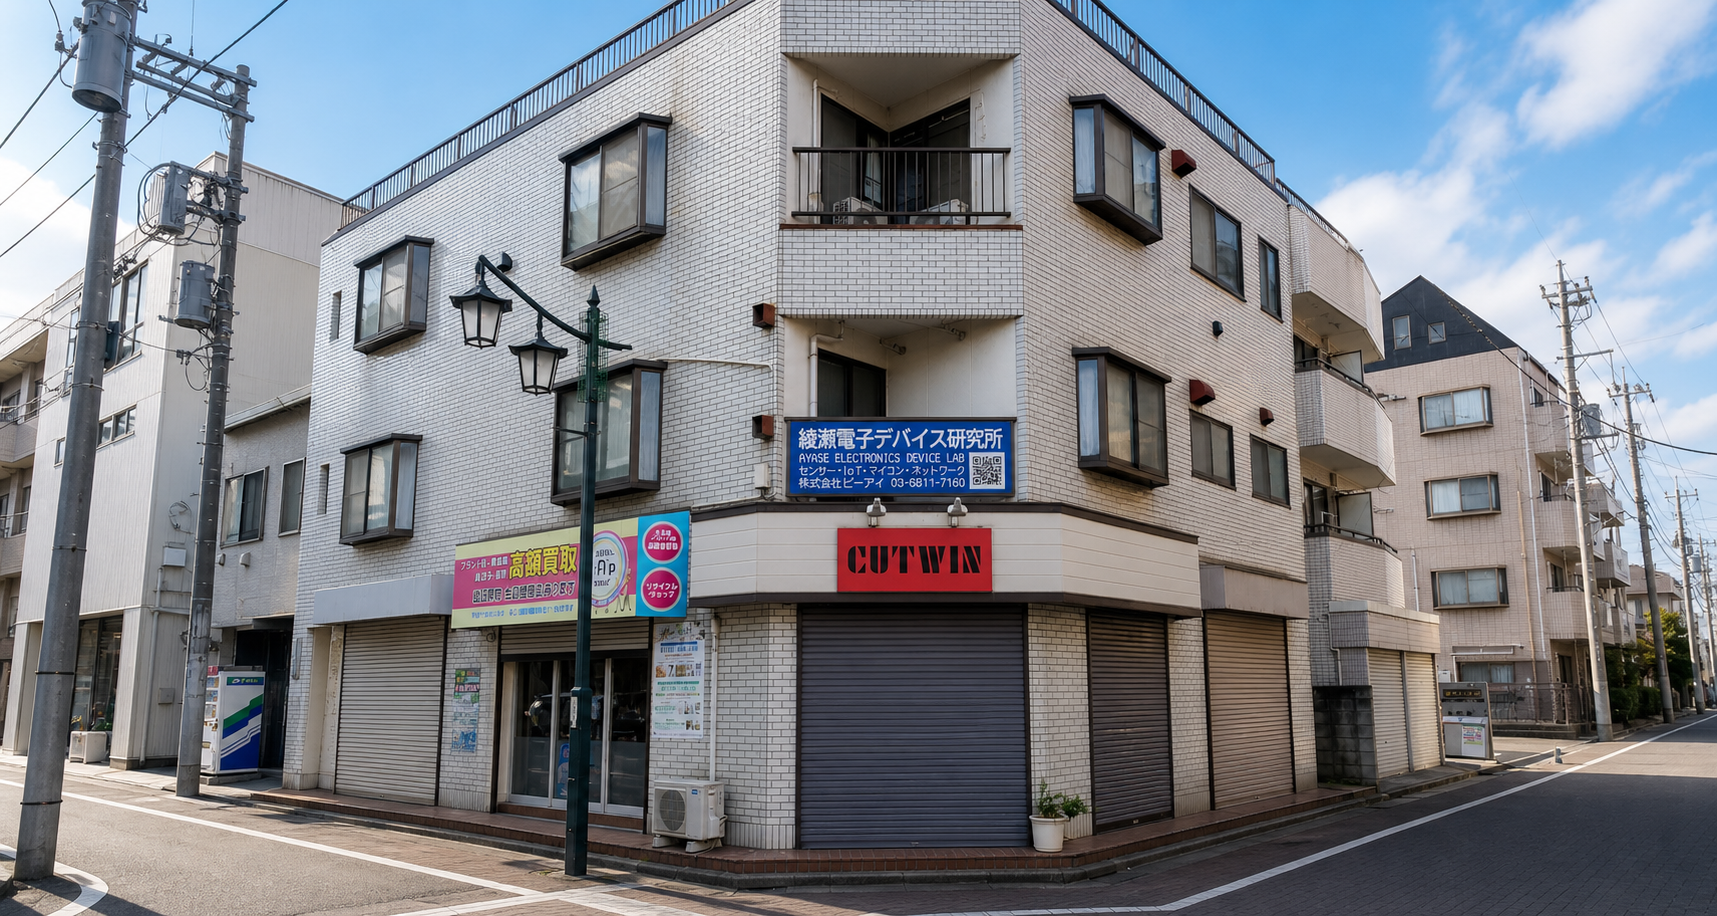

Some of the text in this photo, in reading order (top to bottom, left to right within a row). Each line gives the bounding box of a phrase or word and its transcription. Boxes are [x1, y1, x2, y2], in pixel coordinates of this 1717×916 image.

[798, 427, 1004, 450] 綾瀬電子デバイス研究所
[798, 453, 965, 463] AYASE ELECTRONICS DEVICE LAB
[890, 477, 966, 488] 03-6811-7160
[509, 545, 578, 579] 高額買取
[847, 545, 981, 574] CUTWIN
